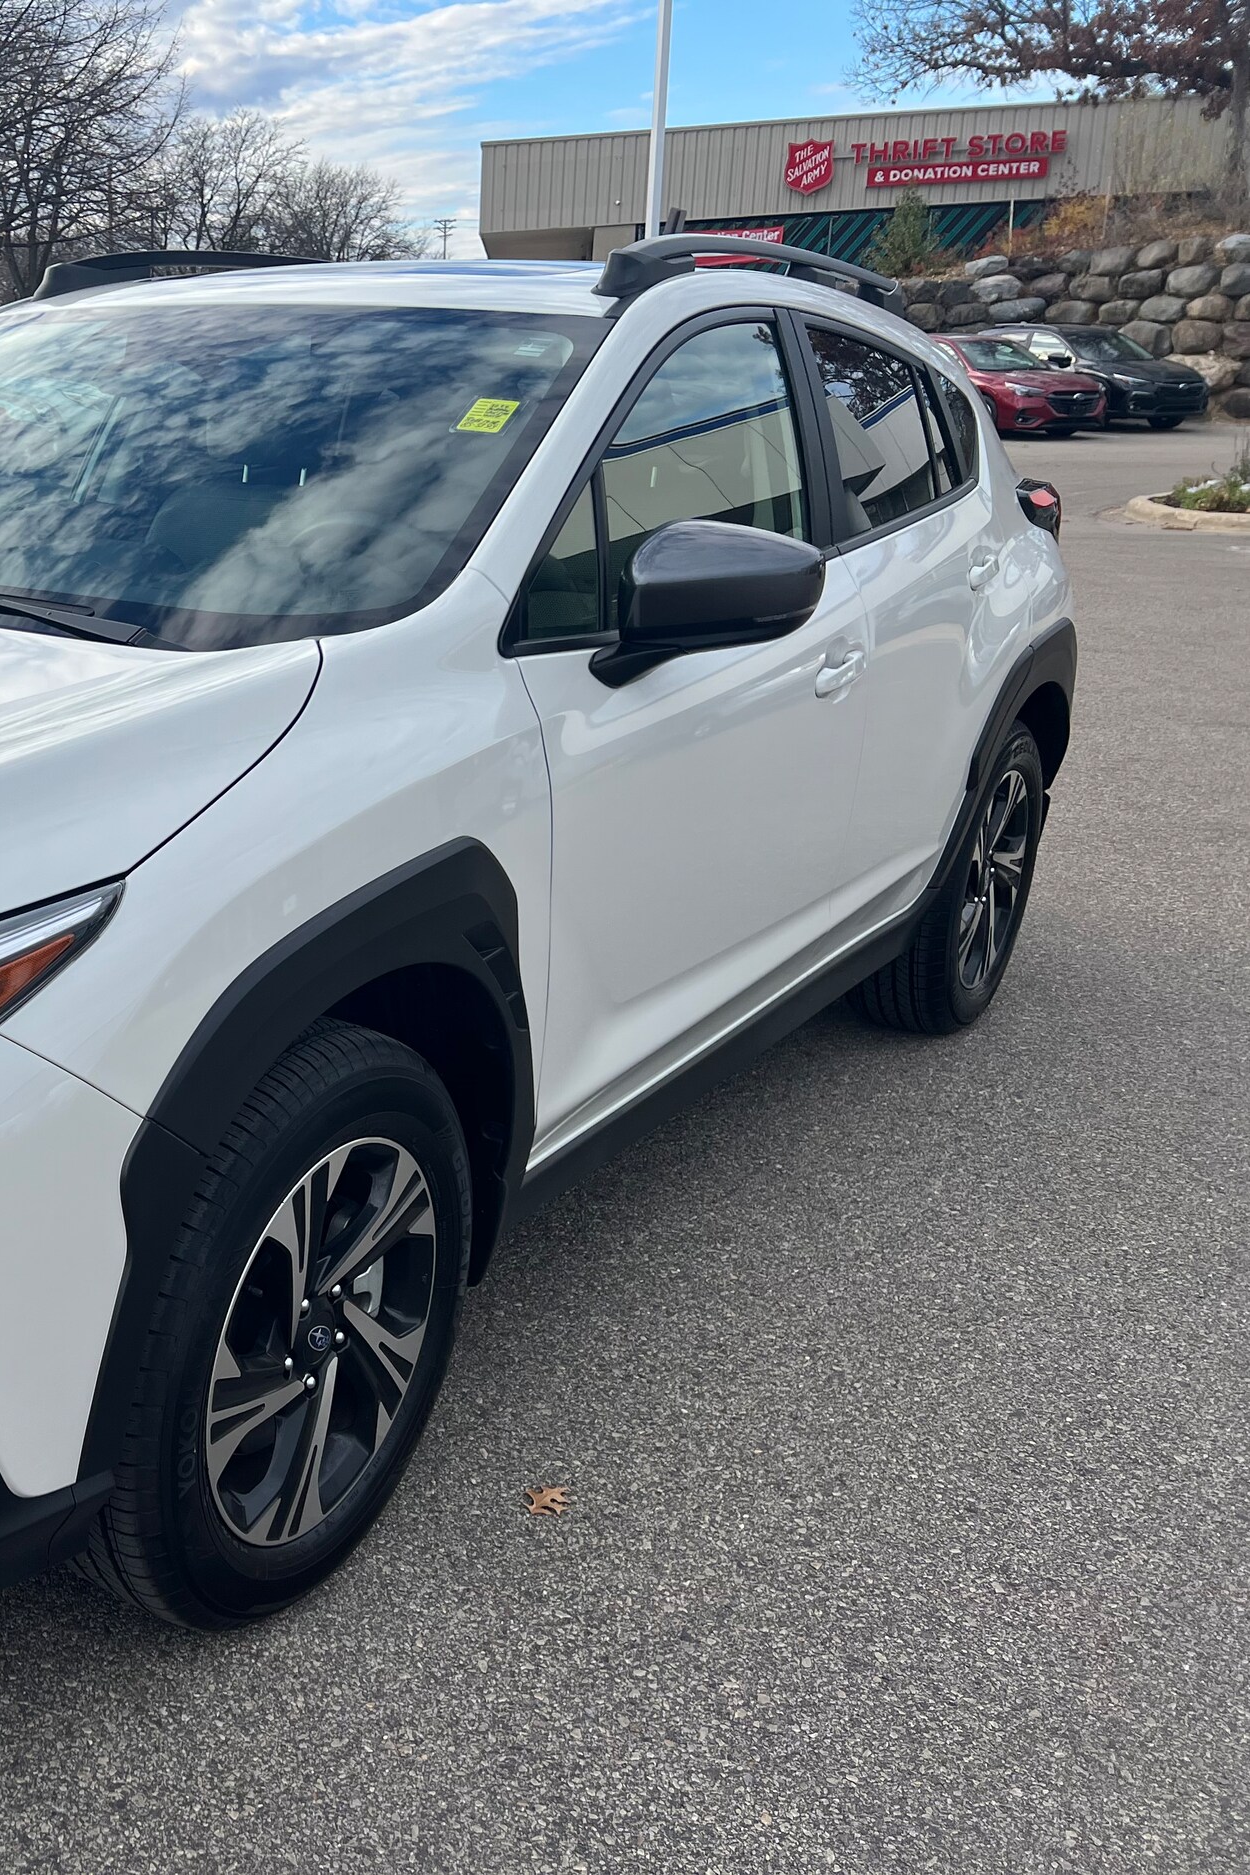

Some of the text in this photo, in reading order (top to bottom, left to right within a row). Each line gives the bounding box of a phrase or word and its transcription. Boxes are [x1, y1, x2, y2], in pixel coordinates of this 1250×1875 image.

[795, 144, 814, 163] THE
[850, 129, 1068, 165] THRIFT STORE
[787, 145, 830, 182] SALVATION
[800, 161, 827, 188] ARMY
[874, 161, 1040, 183] & DONATION CENTER
[742, 229, 781, 241] Center
